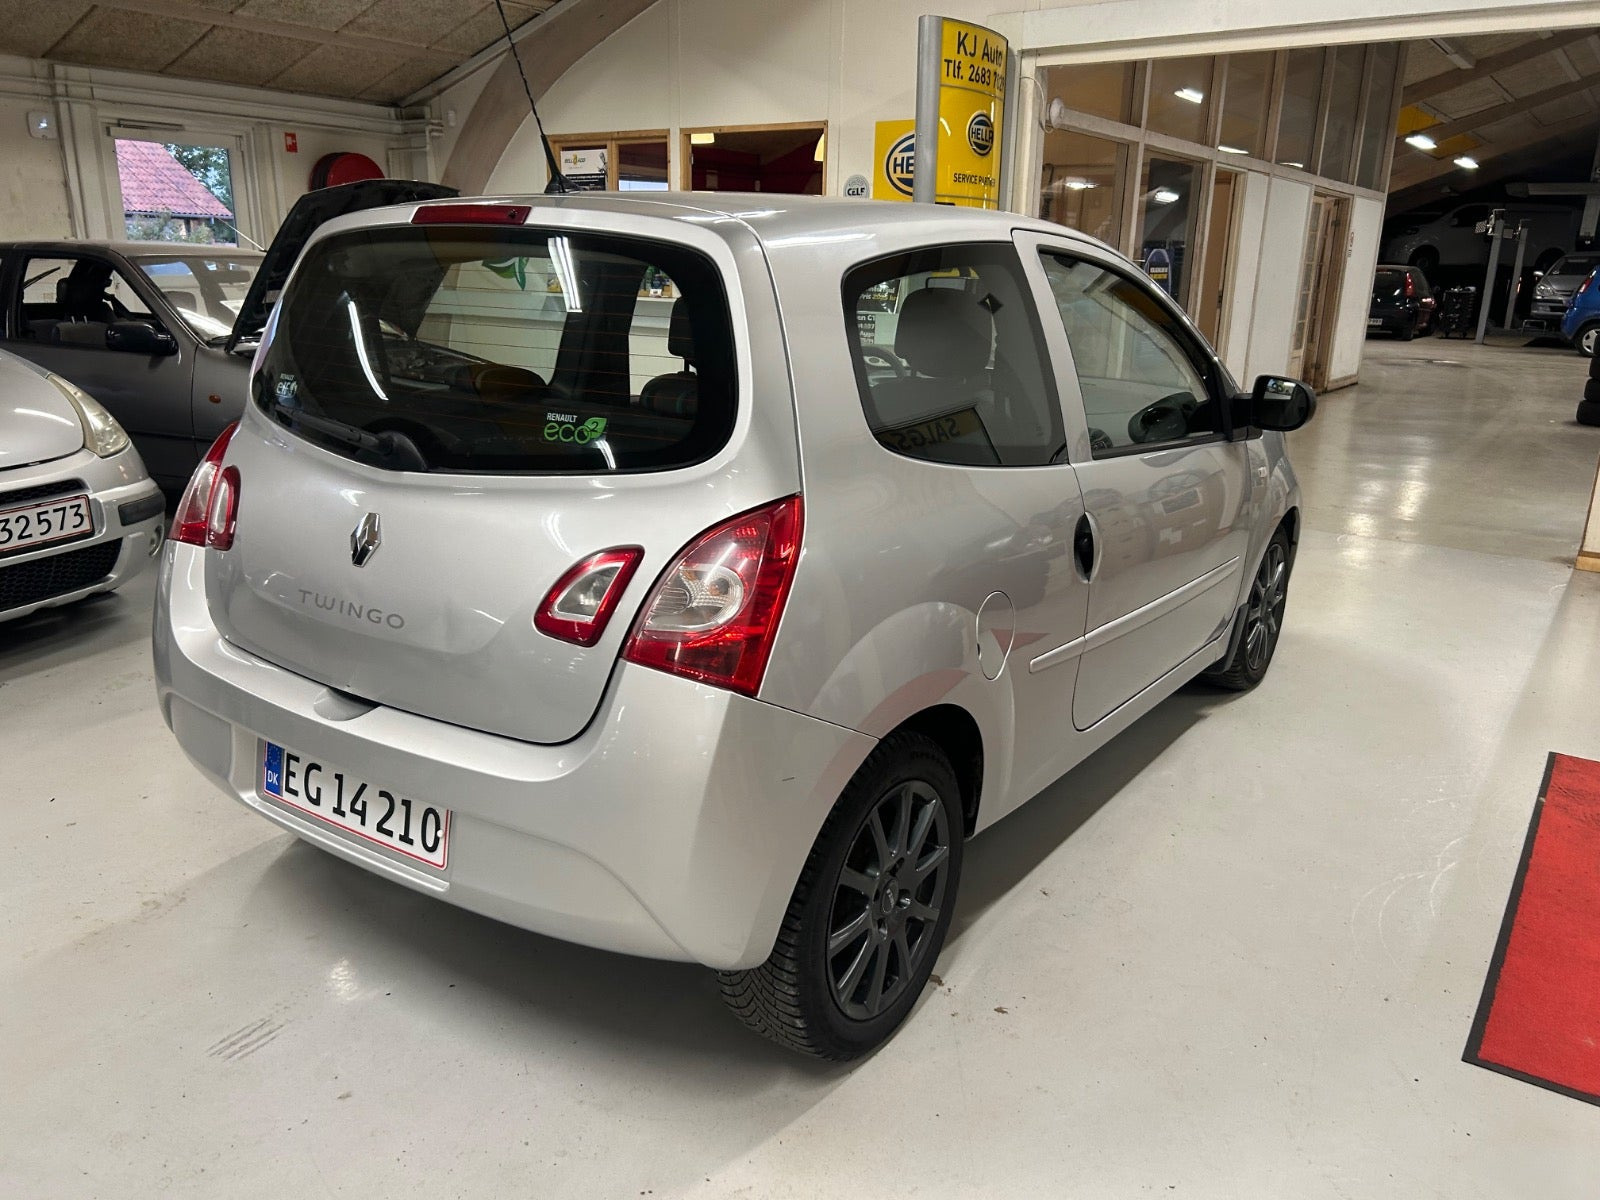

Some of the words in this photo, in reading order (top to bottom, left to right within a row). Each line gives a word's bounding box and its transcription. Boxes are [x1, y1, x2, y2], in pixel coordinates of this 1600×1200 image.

[957, 31, 977, 58] KJ
[982, 38, 1003, 67] Auto
[944, 59, 964, 80] Tlf.
[969, 64, 991, 86] 2683
[953, 172, 978, 185] SERVICE
[546, 412, 578, 423] RENAULT
[298, 588, 405, 629] TWINGO
[267, 770, 278, 785] DK
[284, 752, 322, 807] EG
